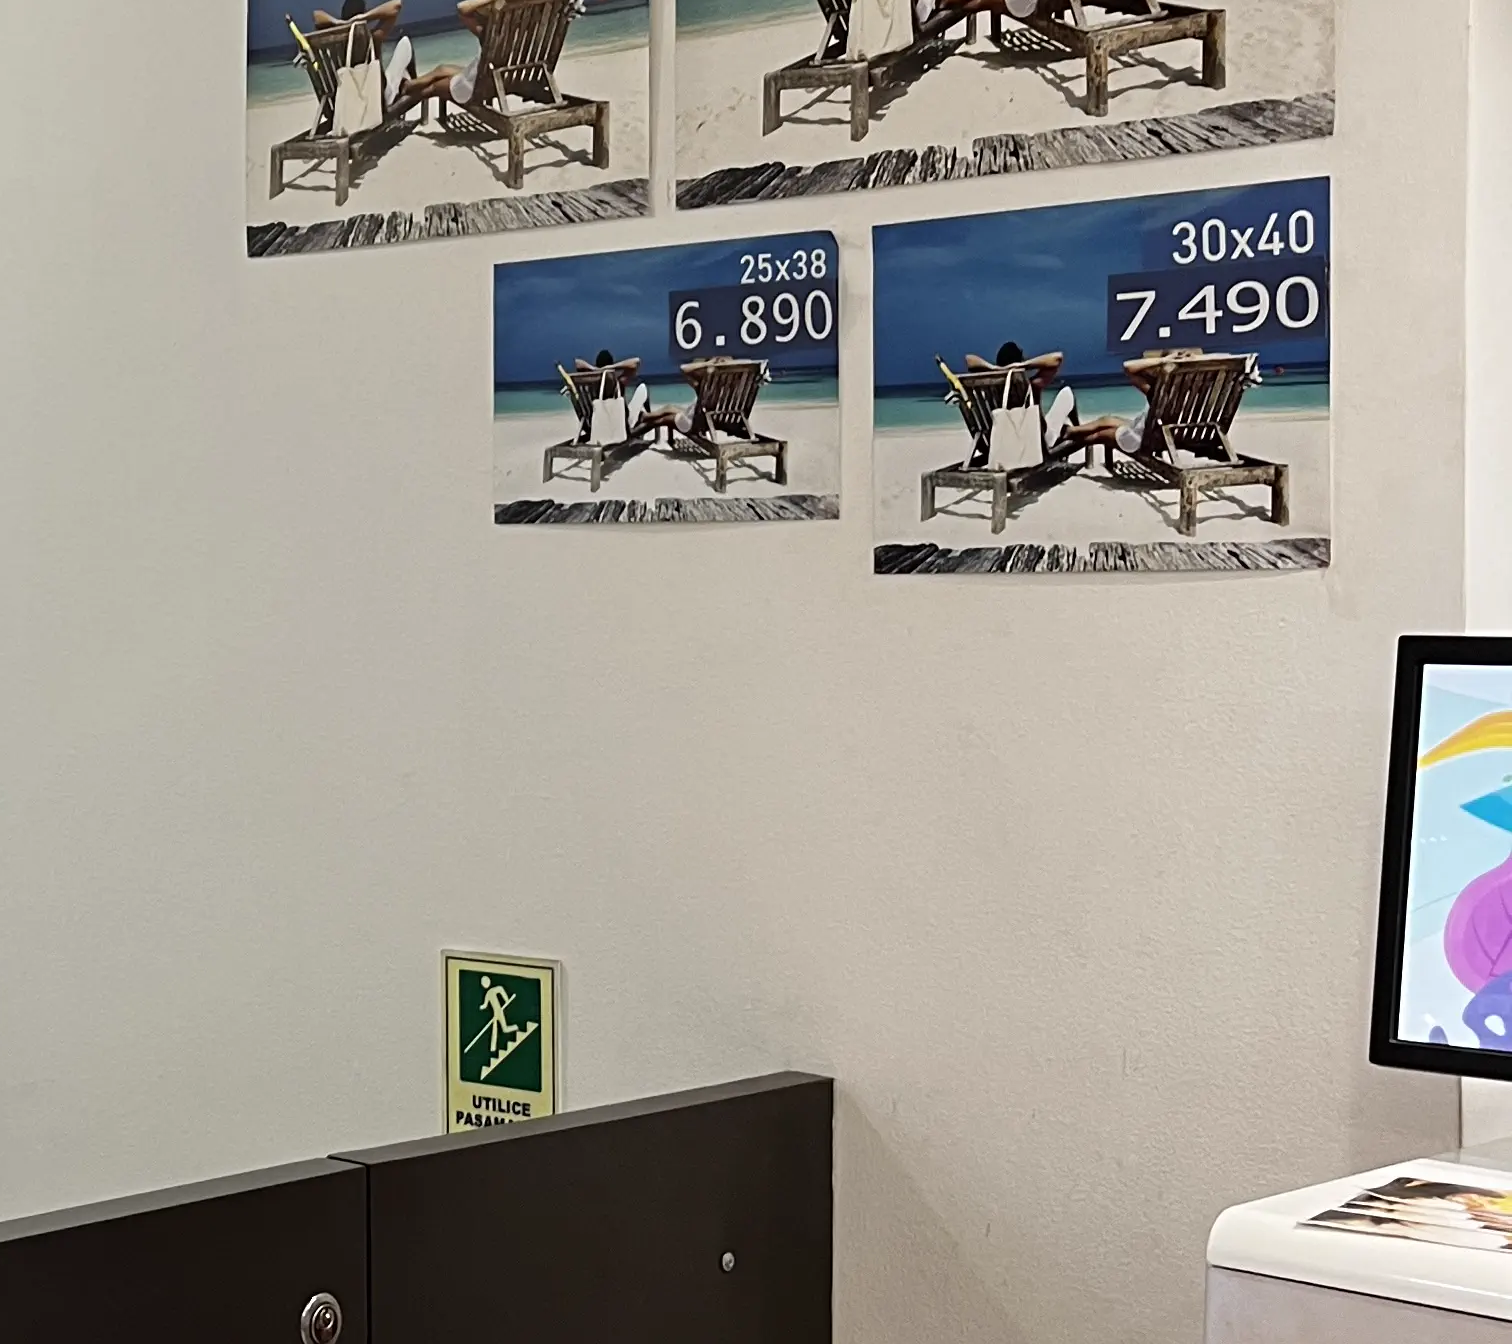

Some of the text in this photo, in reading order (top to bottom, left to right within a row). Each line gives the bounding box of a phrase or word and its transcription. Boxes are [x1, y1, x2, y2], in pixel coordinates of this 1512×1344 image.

[1172, 209, 1315, 265] 30x40
[740, 248, 826, 285] 25x38
[675, 289, 834, 350] 6.890
[1116, 275, 1320, 342] 7.490
[456, 1110, 514, 1127] PASAM
[472, 1094, 531, 1117] UTILICE
